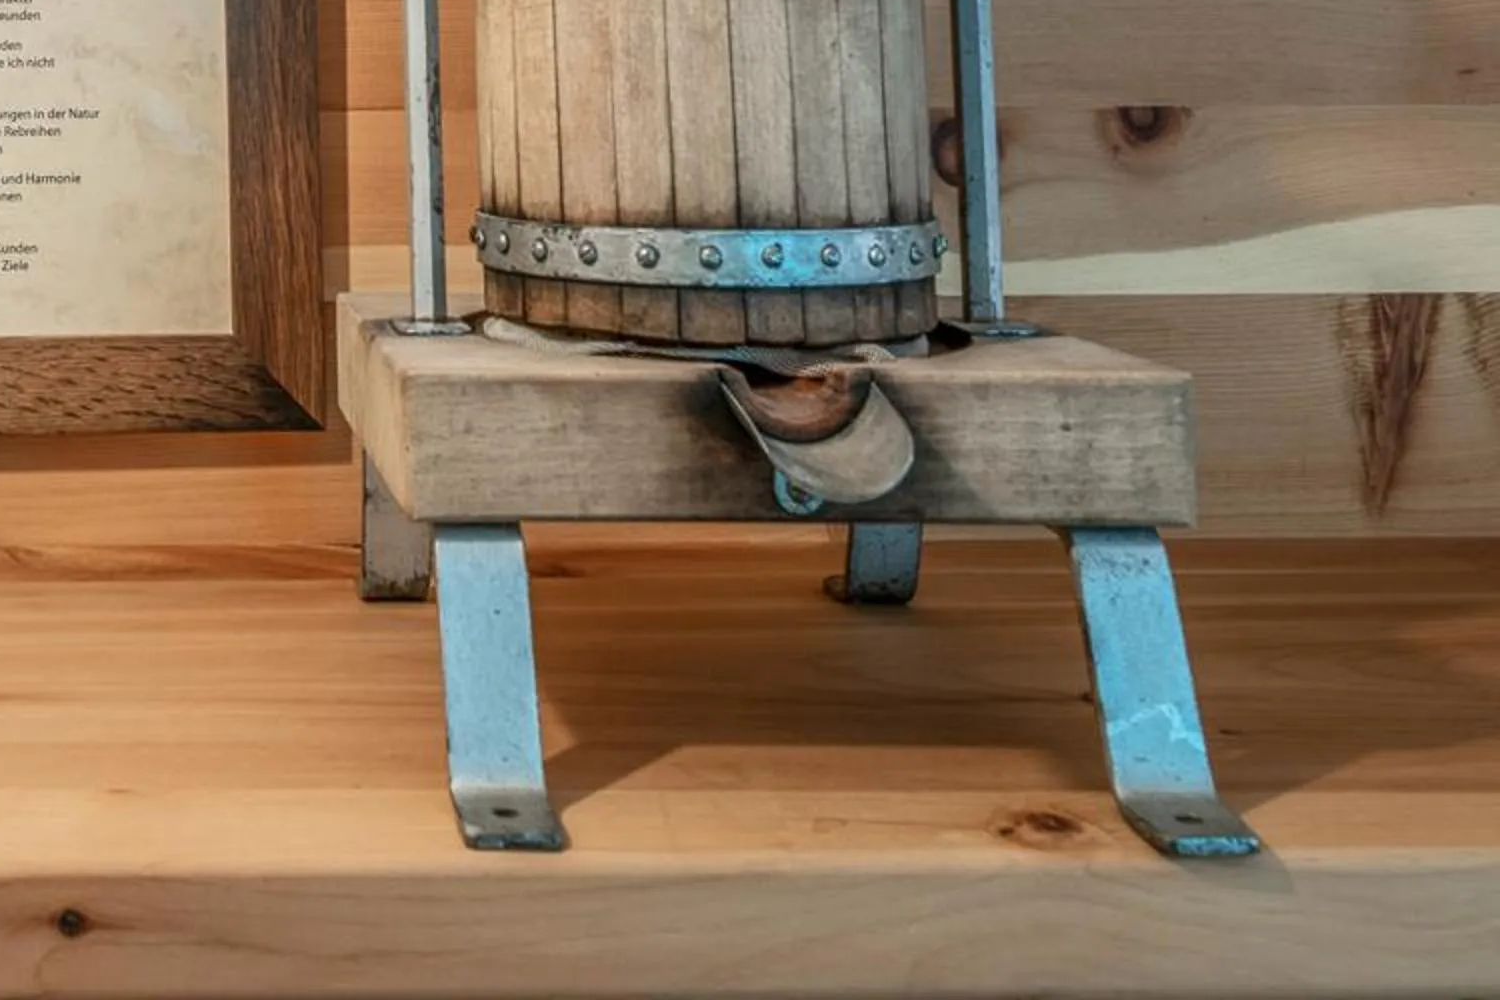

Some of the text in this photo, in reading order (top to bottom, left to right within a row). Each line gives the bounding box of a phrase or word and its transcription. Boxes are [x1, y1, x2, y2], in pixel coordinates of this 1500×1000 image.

[8, 57, 24, 68] ich
[27, 56, 55, 68] nicht
[34, 108, 45, 120] in
[48, 108, 66, 120] der
[69, 108, 99, 120] Natur
[2, 174, 23, 185] und
[26, 173, 81, 185] Harmonie
[2, 260, 28, 272] Ziele
